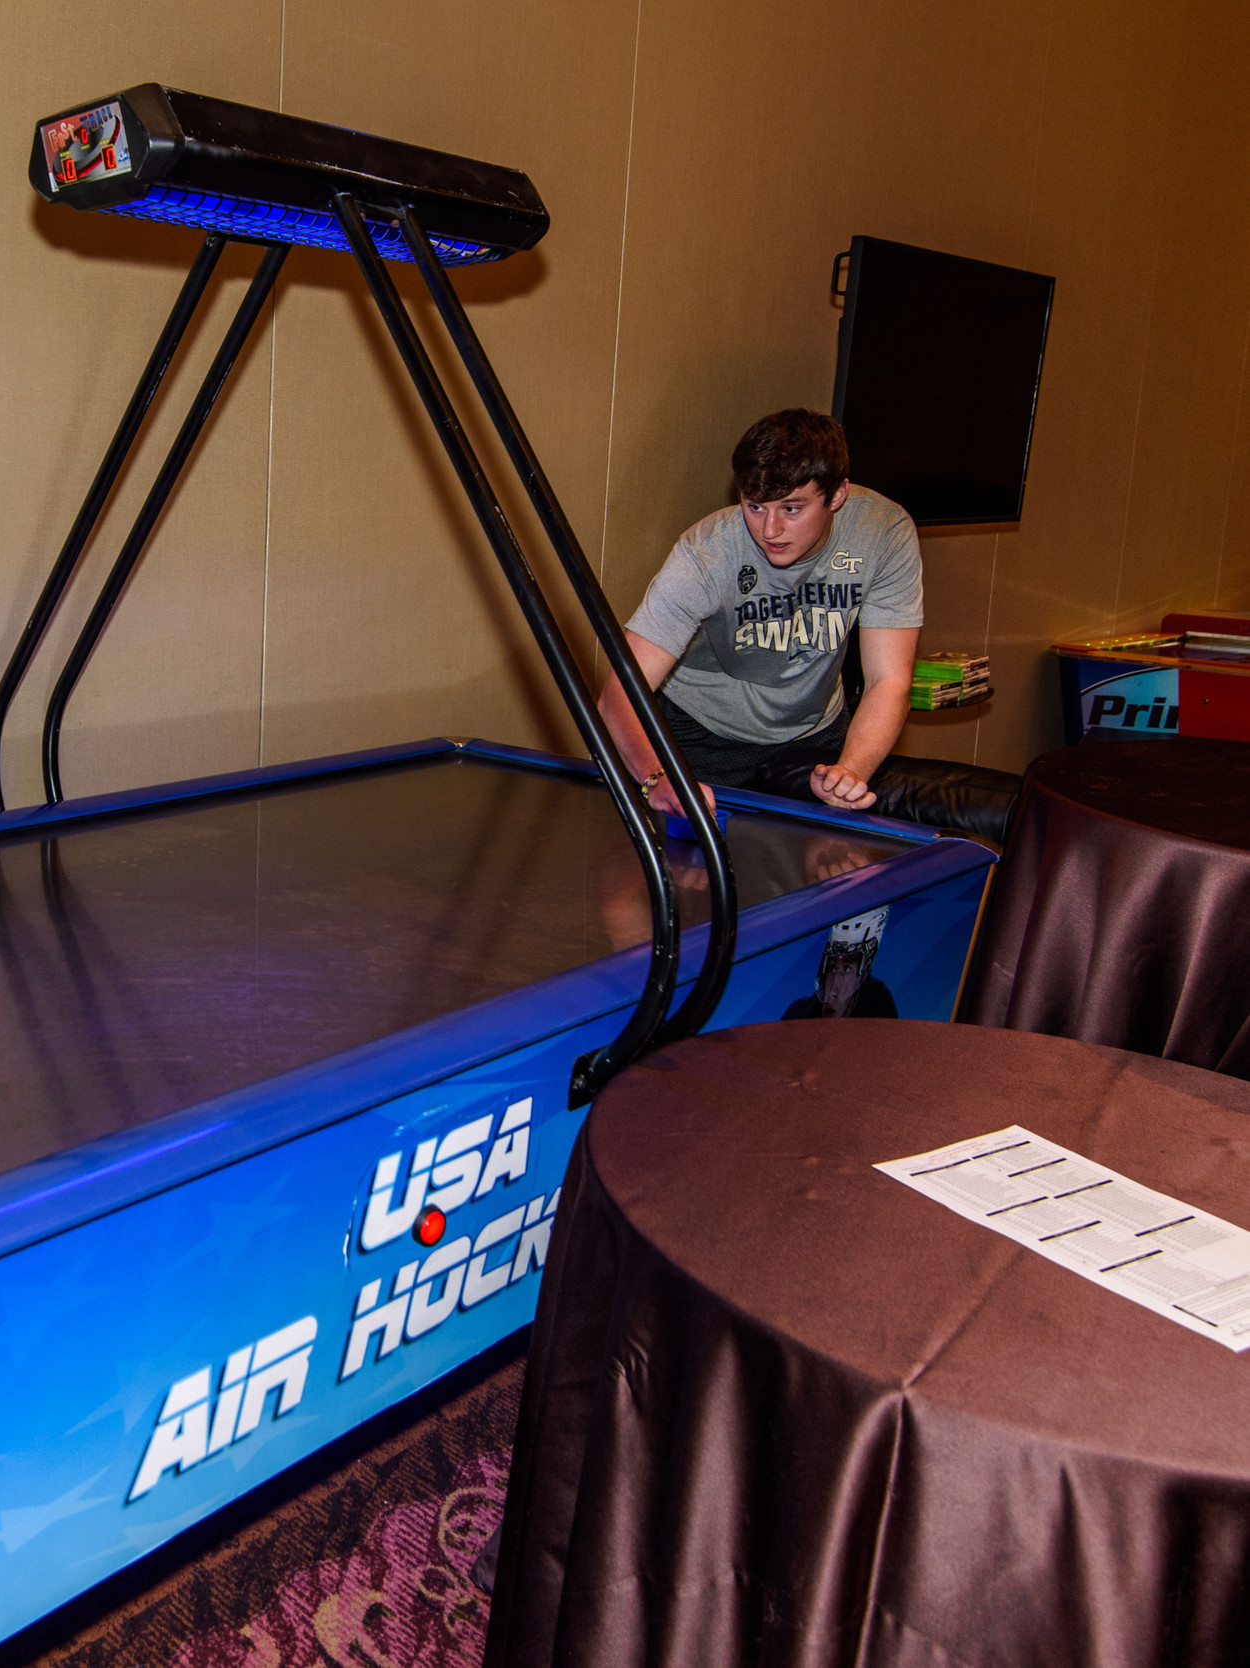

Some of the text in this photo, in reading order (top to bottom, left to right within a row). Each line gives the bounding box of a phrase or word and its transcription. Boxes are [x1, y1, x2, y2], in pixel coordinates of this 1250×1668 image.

[79, 105, 114, 134] TRACK
[830, 550, 863, 574] GT
[827, 583, 863, 609] WE
[734, 606, 862, 652] SWARM
[361, 1096, 533, 1251] USA
[125, 1315, 318, 1504] AIR
